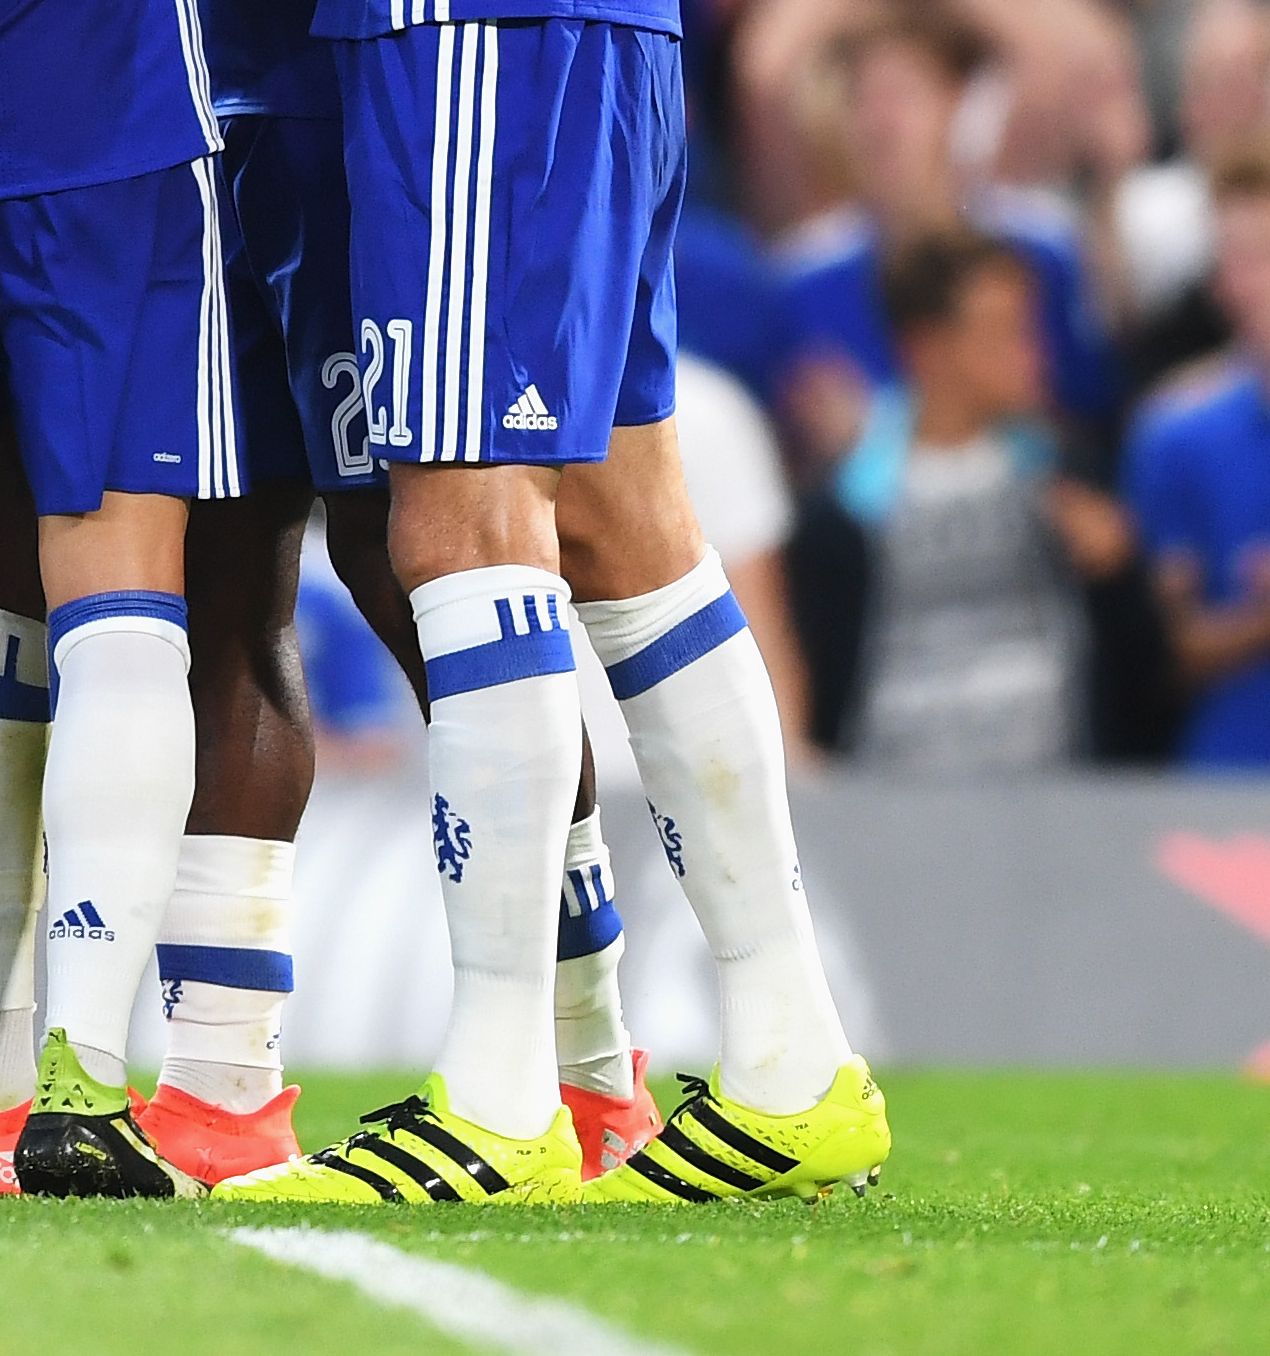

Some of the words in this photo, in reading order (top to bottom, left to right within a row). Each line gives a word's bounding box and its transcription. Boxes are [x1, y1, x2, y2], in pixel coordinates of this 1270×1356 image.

[321, 351, 374, 477] 2
[361, 318, 413, 447] 21
[502, 414, 558, 430] adidas
[49, 923, 116, 942] adidas
